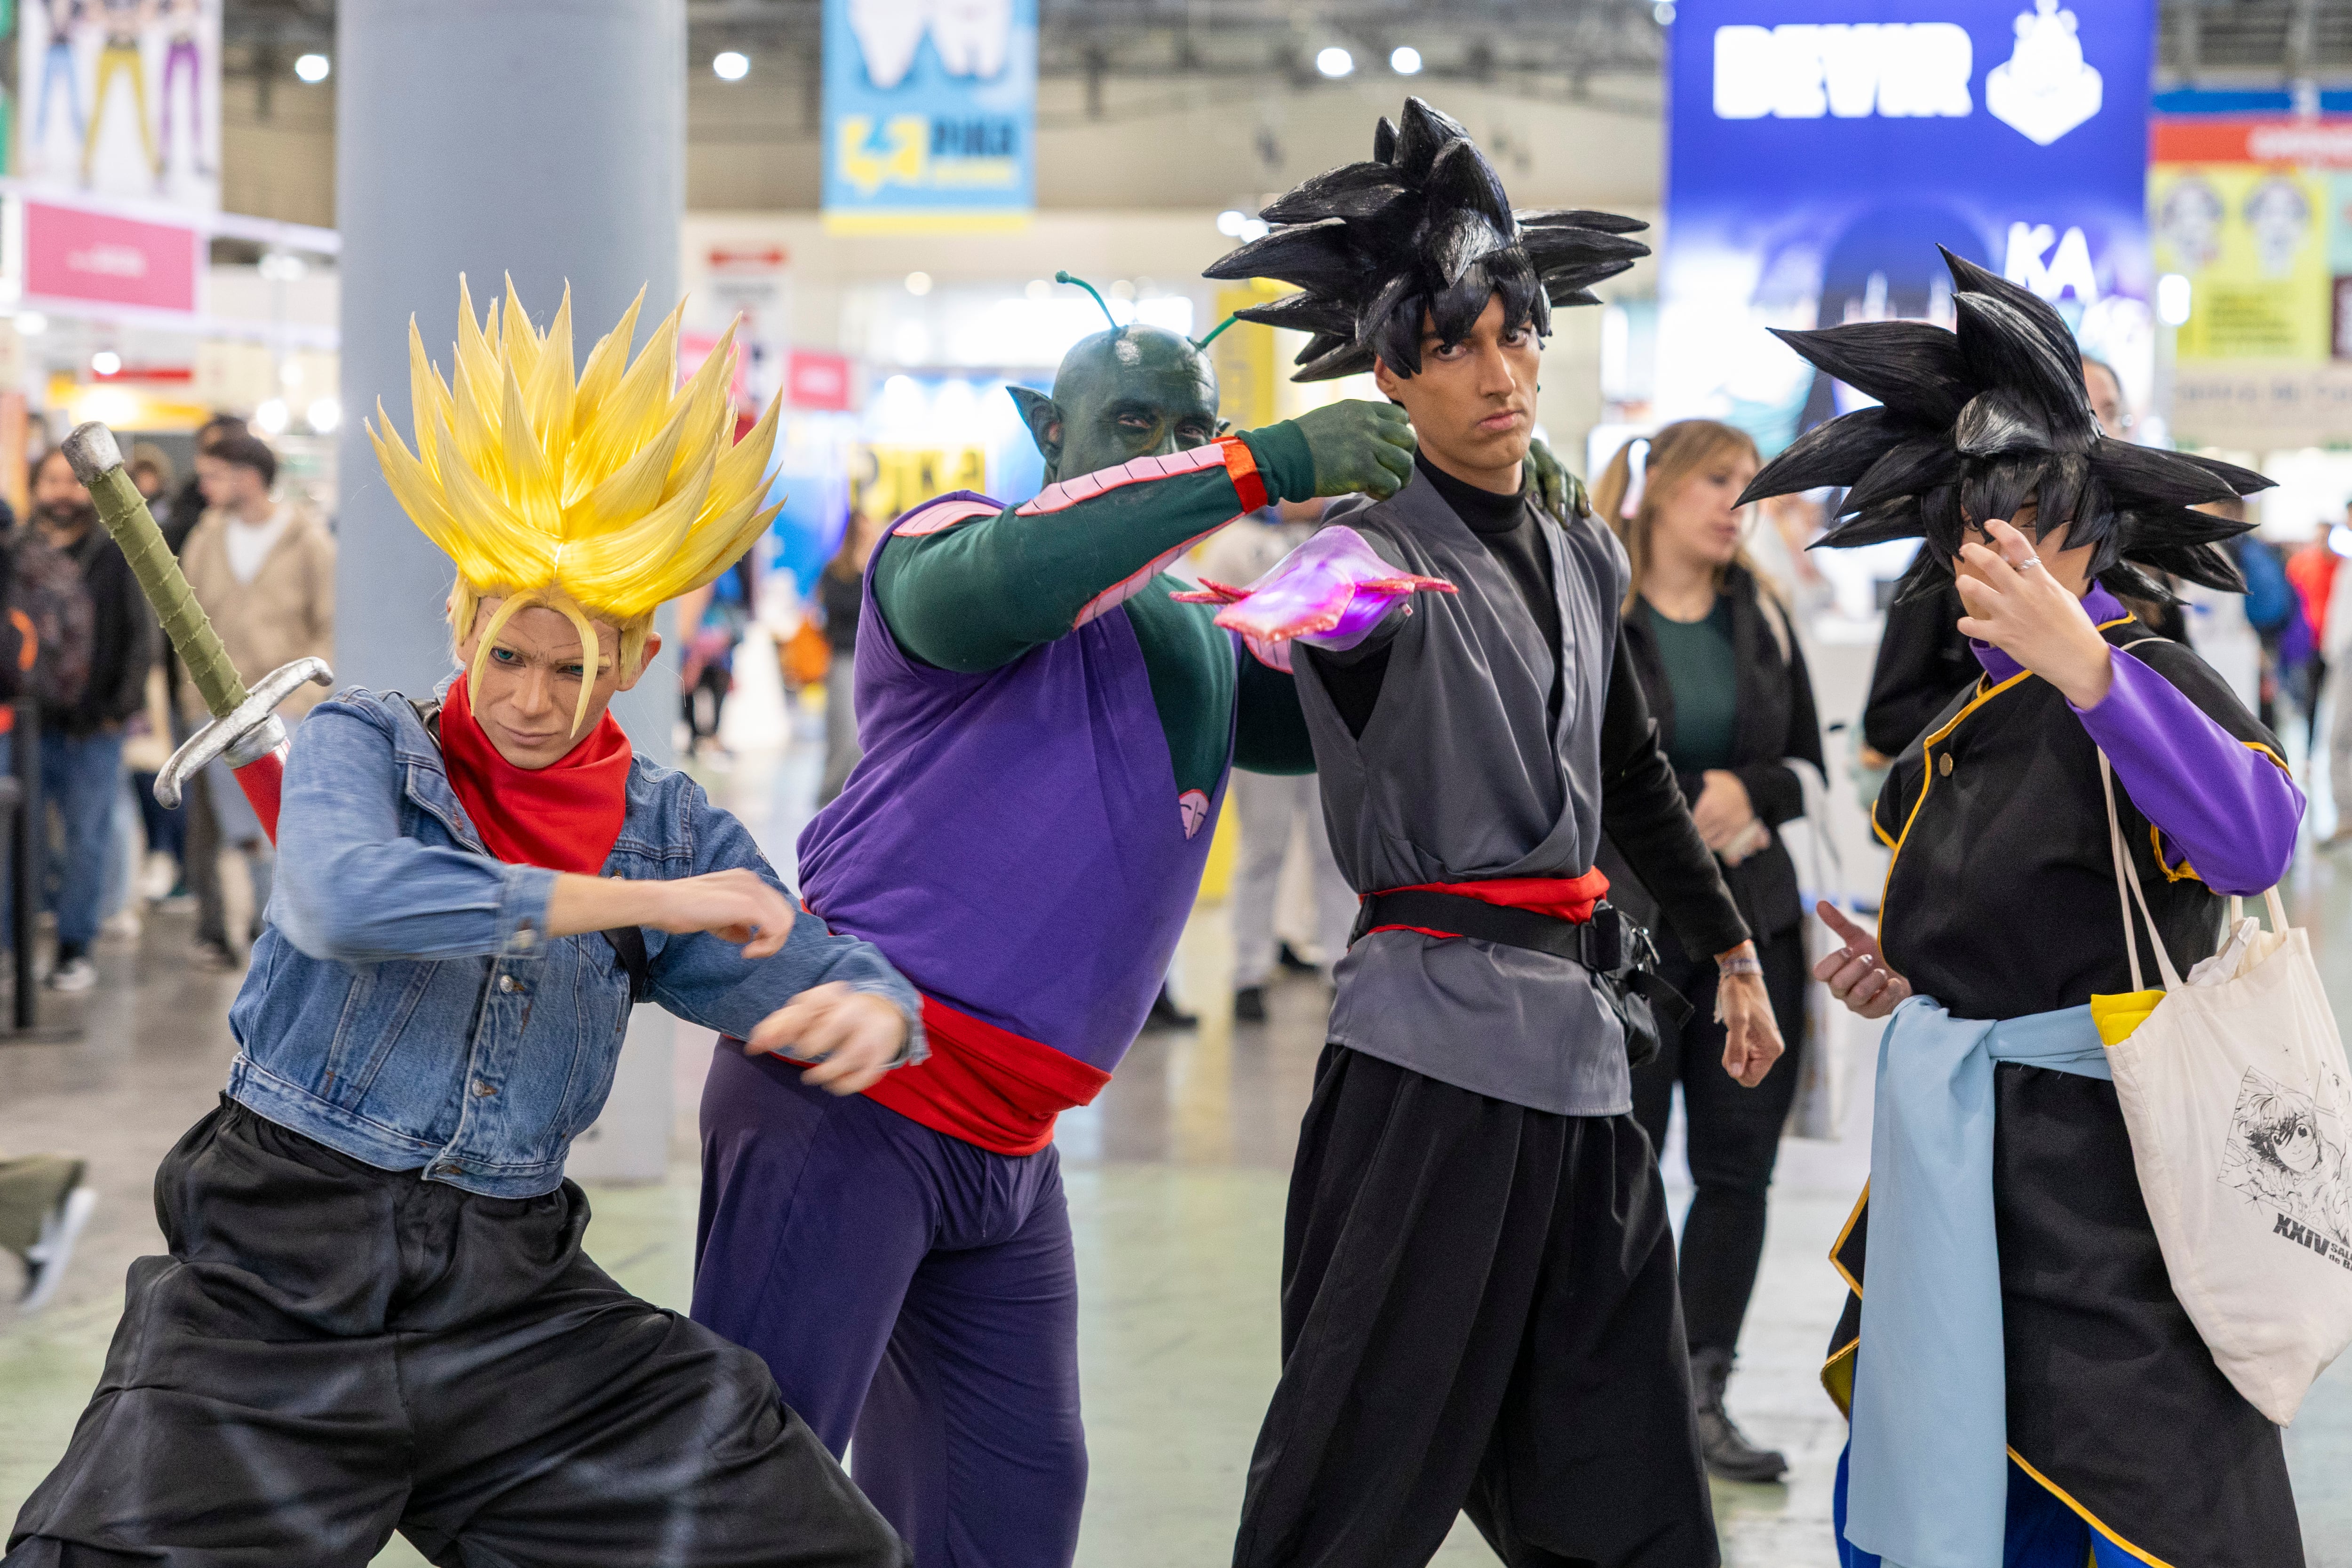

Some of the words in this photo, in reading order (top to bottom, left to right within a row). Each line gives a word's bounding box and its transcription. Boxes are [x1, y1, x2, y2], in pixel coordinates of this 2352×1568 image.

[2273, 1213, 2330, 1256] XXIV
[2331, 1243, 2352, 1260] SAL
[2343, 1259, 2352, 1271] B
